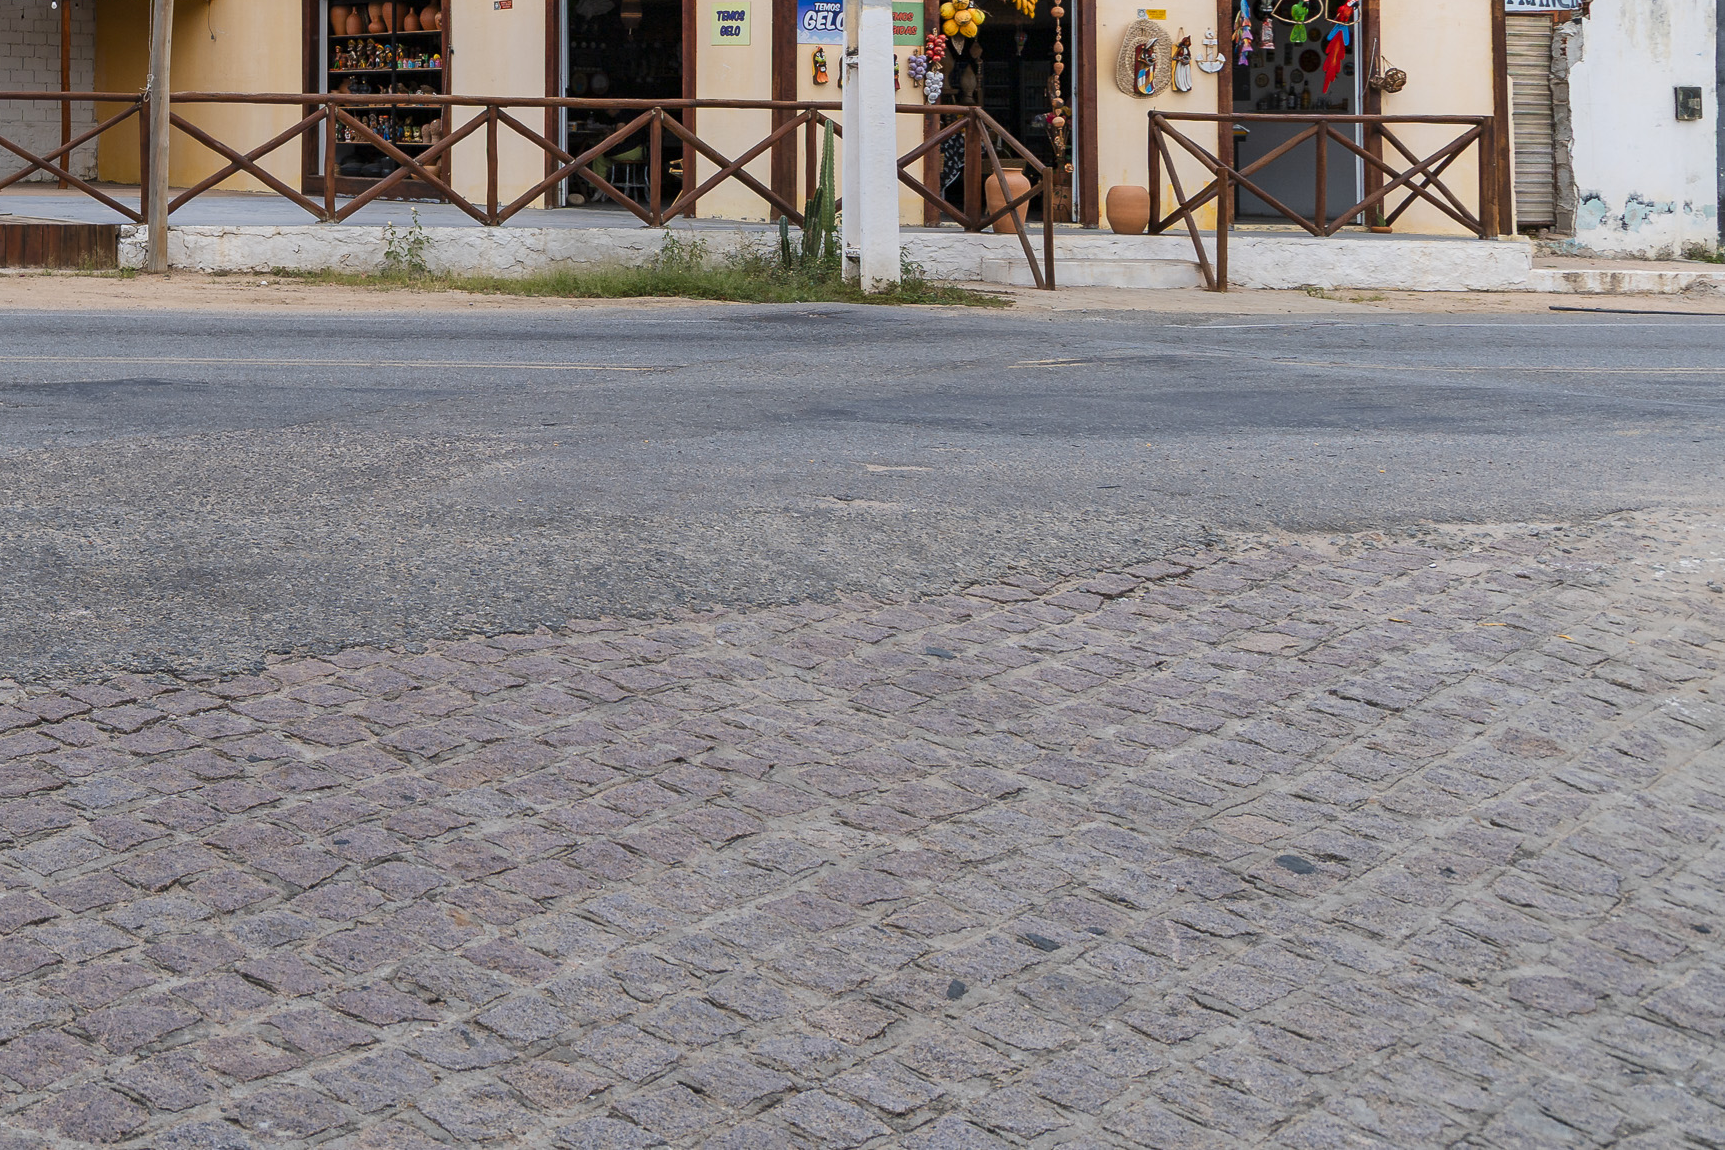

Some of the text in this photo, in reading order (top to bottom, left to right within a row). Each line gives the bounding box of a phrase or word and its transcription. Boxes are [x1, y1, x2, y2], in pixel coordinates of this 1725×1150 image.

[815, 2, 841, 12] TEMOS
[716, 10, 746, 21] TEMOS
[720, 25, 741, 36] GELO
